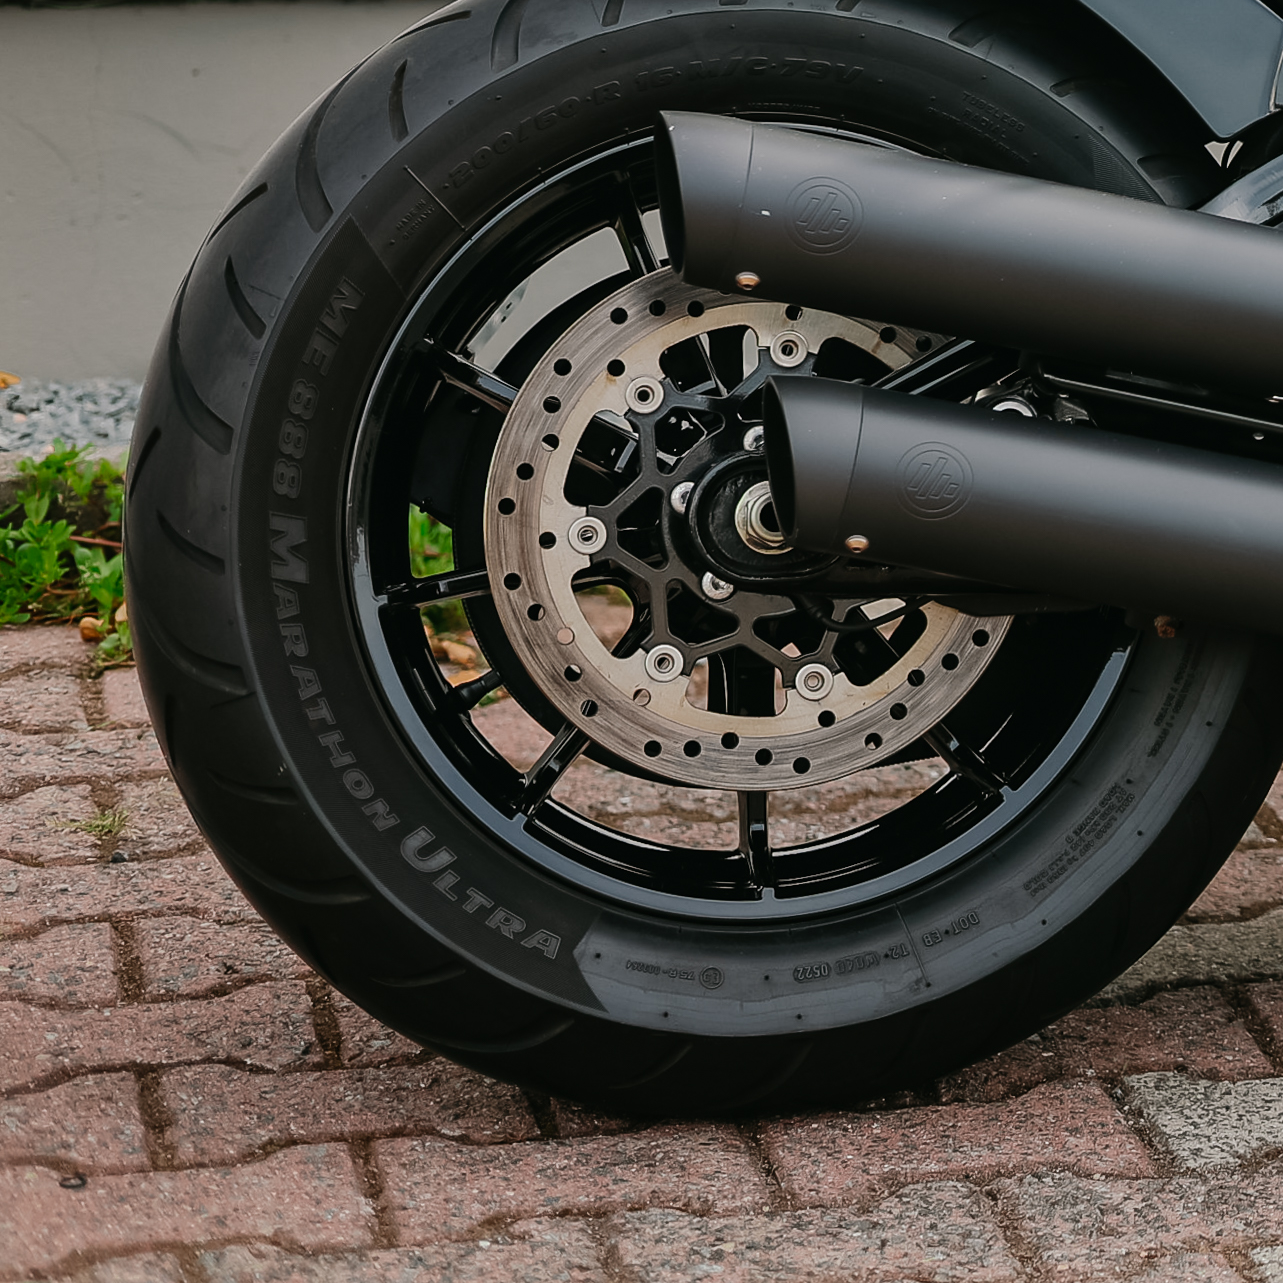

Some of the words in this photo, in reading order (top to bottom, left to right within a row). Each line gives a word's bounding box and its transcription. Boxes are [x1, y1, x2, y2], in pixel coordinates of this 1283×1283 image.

[301, 275, 367, 377] ME
[271, 378, 320, 499] 888
[268, 511, 400, 832] MARATHON
[400, 826, 563, 960] ULTRA
[796, 964, 829, 979] 0522
